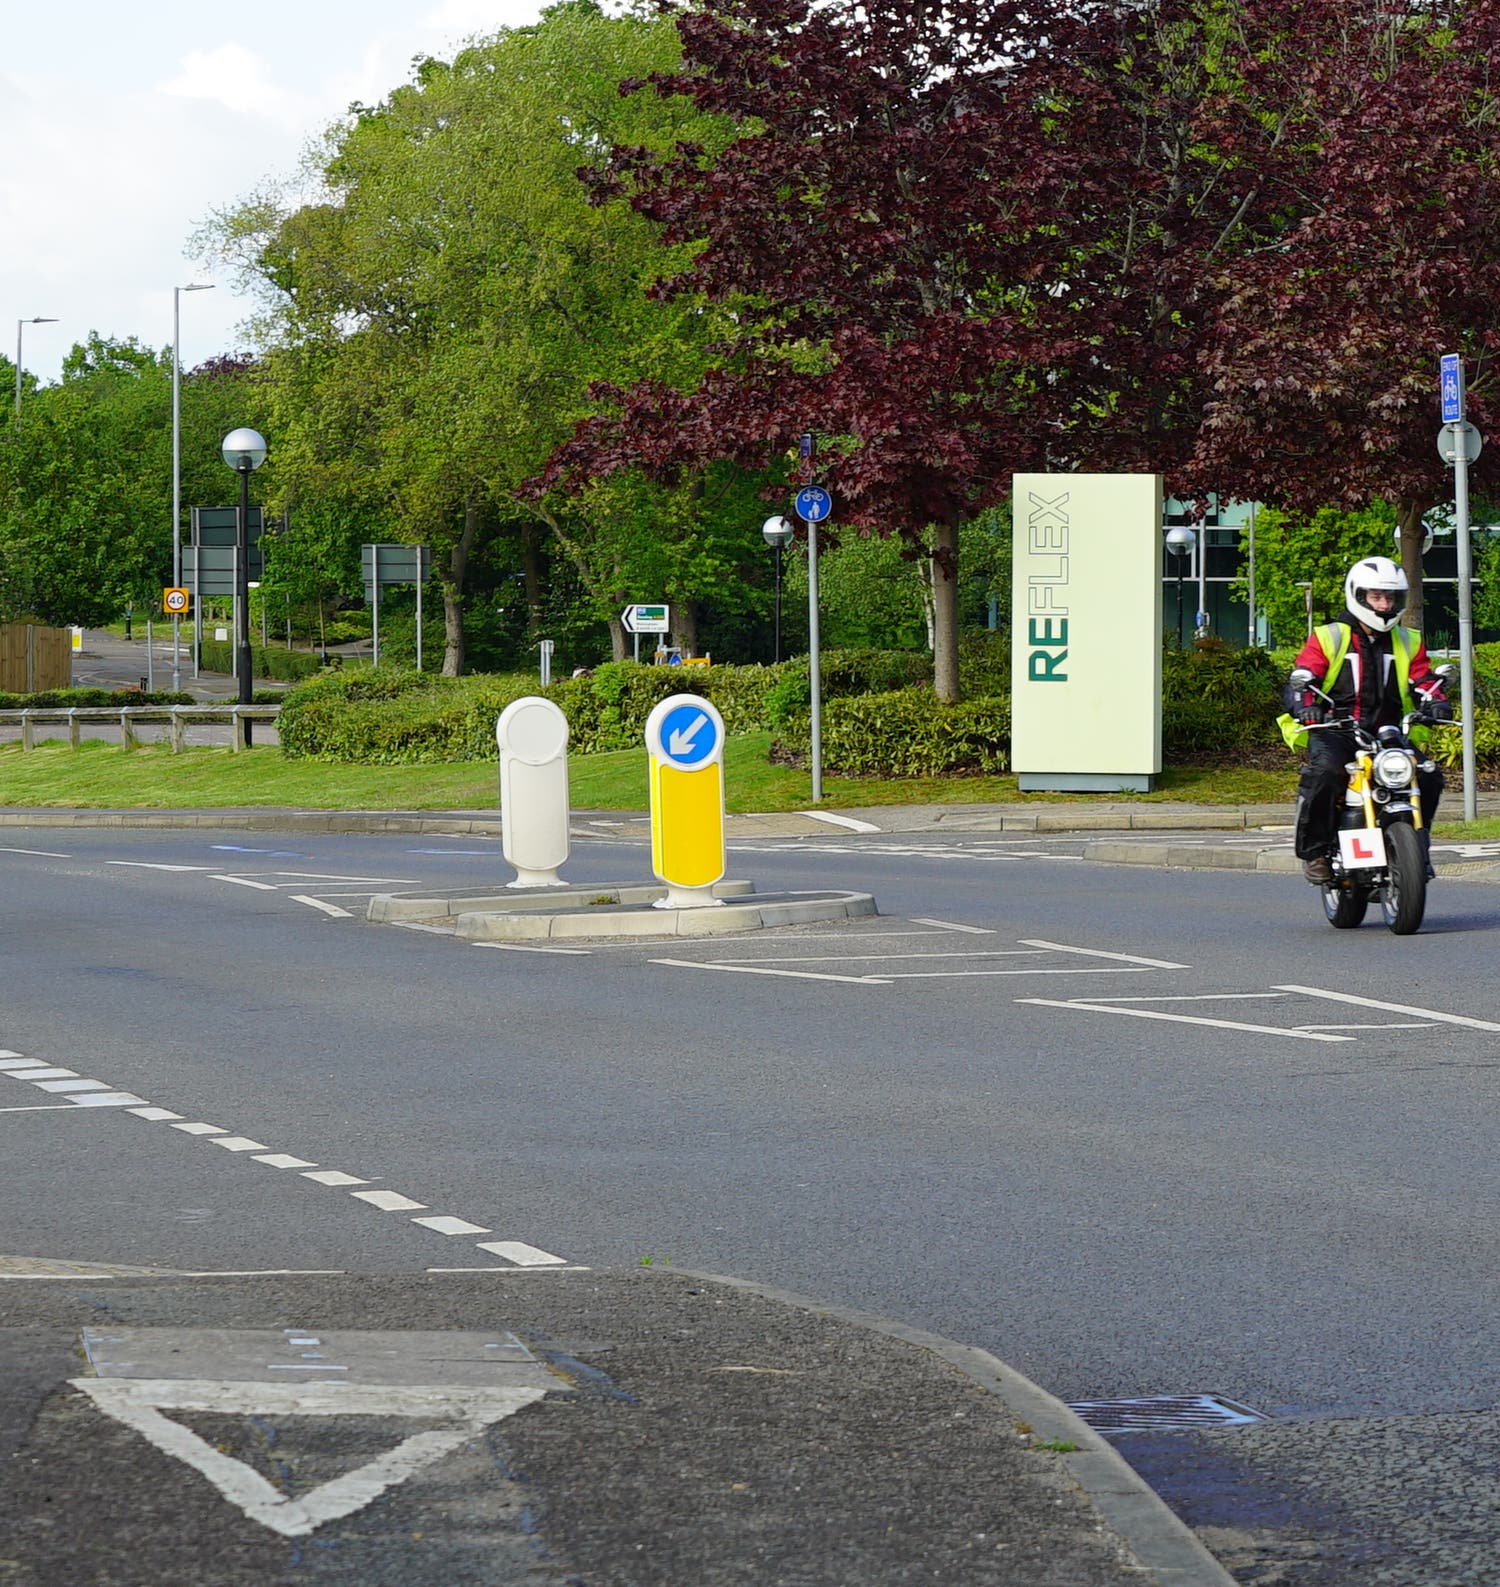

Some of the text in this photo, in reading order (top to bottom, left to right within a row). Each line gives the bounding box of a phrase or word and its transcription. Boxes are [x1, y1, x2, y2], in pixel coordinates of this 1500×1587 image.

[1028, 492, 1069, 682] REFLEX
[169, 596, 184, 605] 40
[1352, 838, 1373, 859] L
